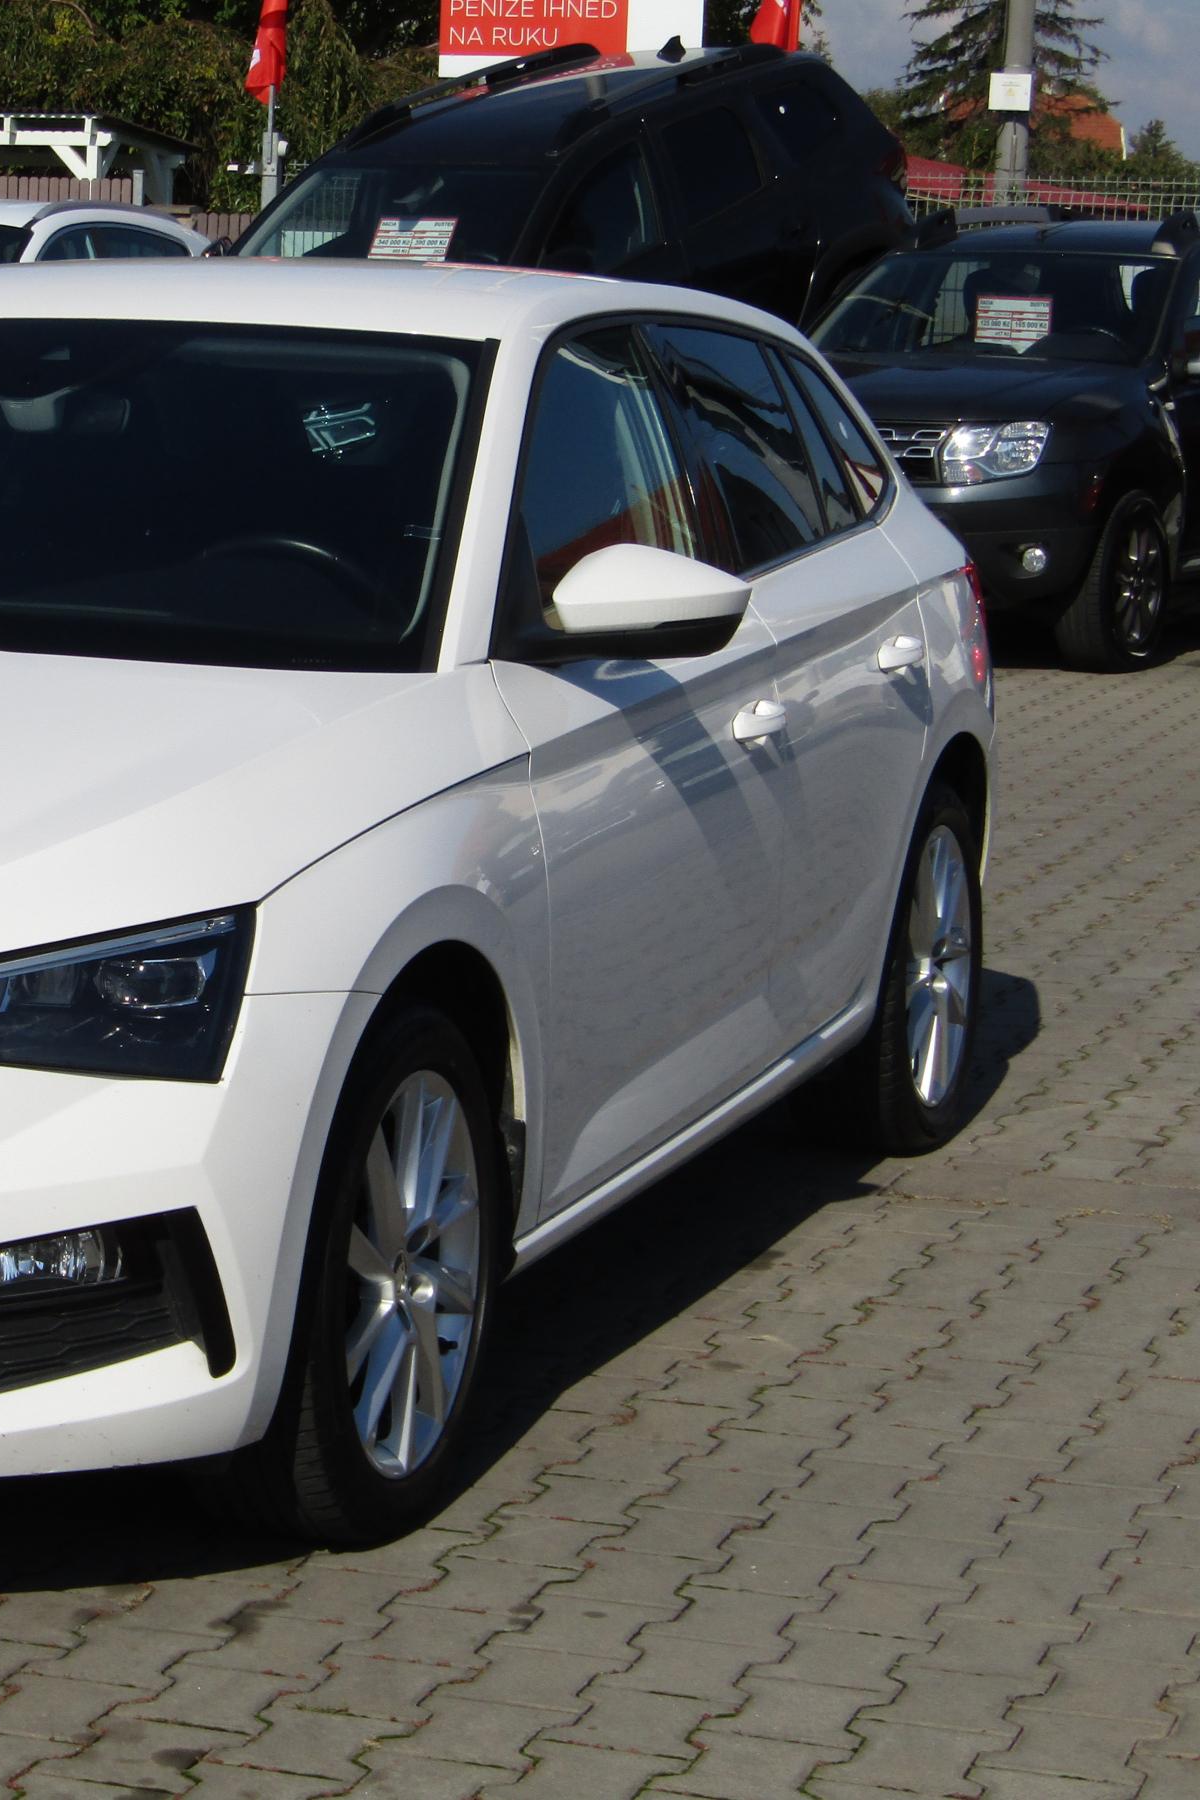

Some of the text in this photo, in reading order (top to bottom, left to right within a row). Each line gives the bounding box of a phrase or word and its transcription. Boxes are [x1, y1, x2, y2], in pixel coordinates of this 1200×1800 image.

[543, 0, 618, 19] IHNED
[449, 26, 559, 47] NA RUKU
